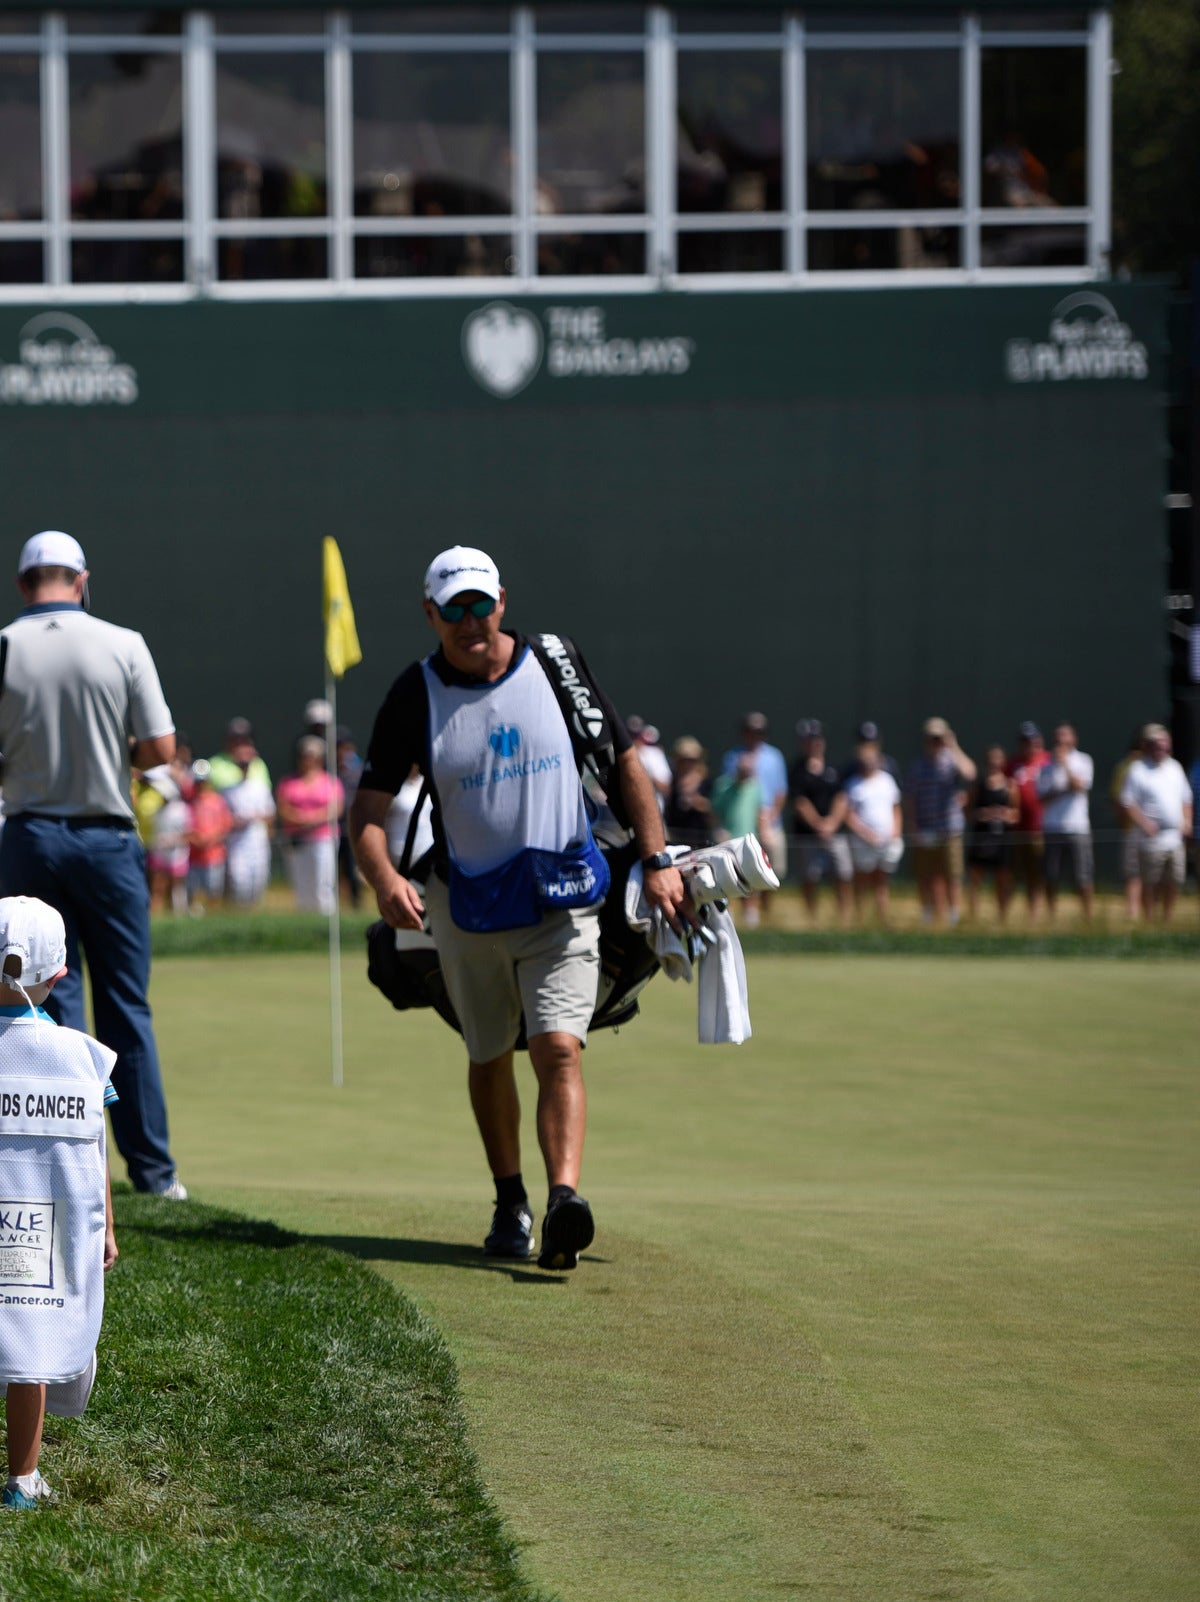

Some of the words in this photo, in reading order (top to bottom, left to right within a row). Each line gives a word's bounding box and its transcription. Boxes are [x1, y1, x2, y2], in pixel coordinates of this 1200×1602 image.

[460, 772, 486, 791] THE
[492, 753, 561, 784] BARCLAYS
[25, 1094, 85, 1120] CANCER
